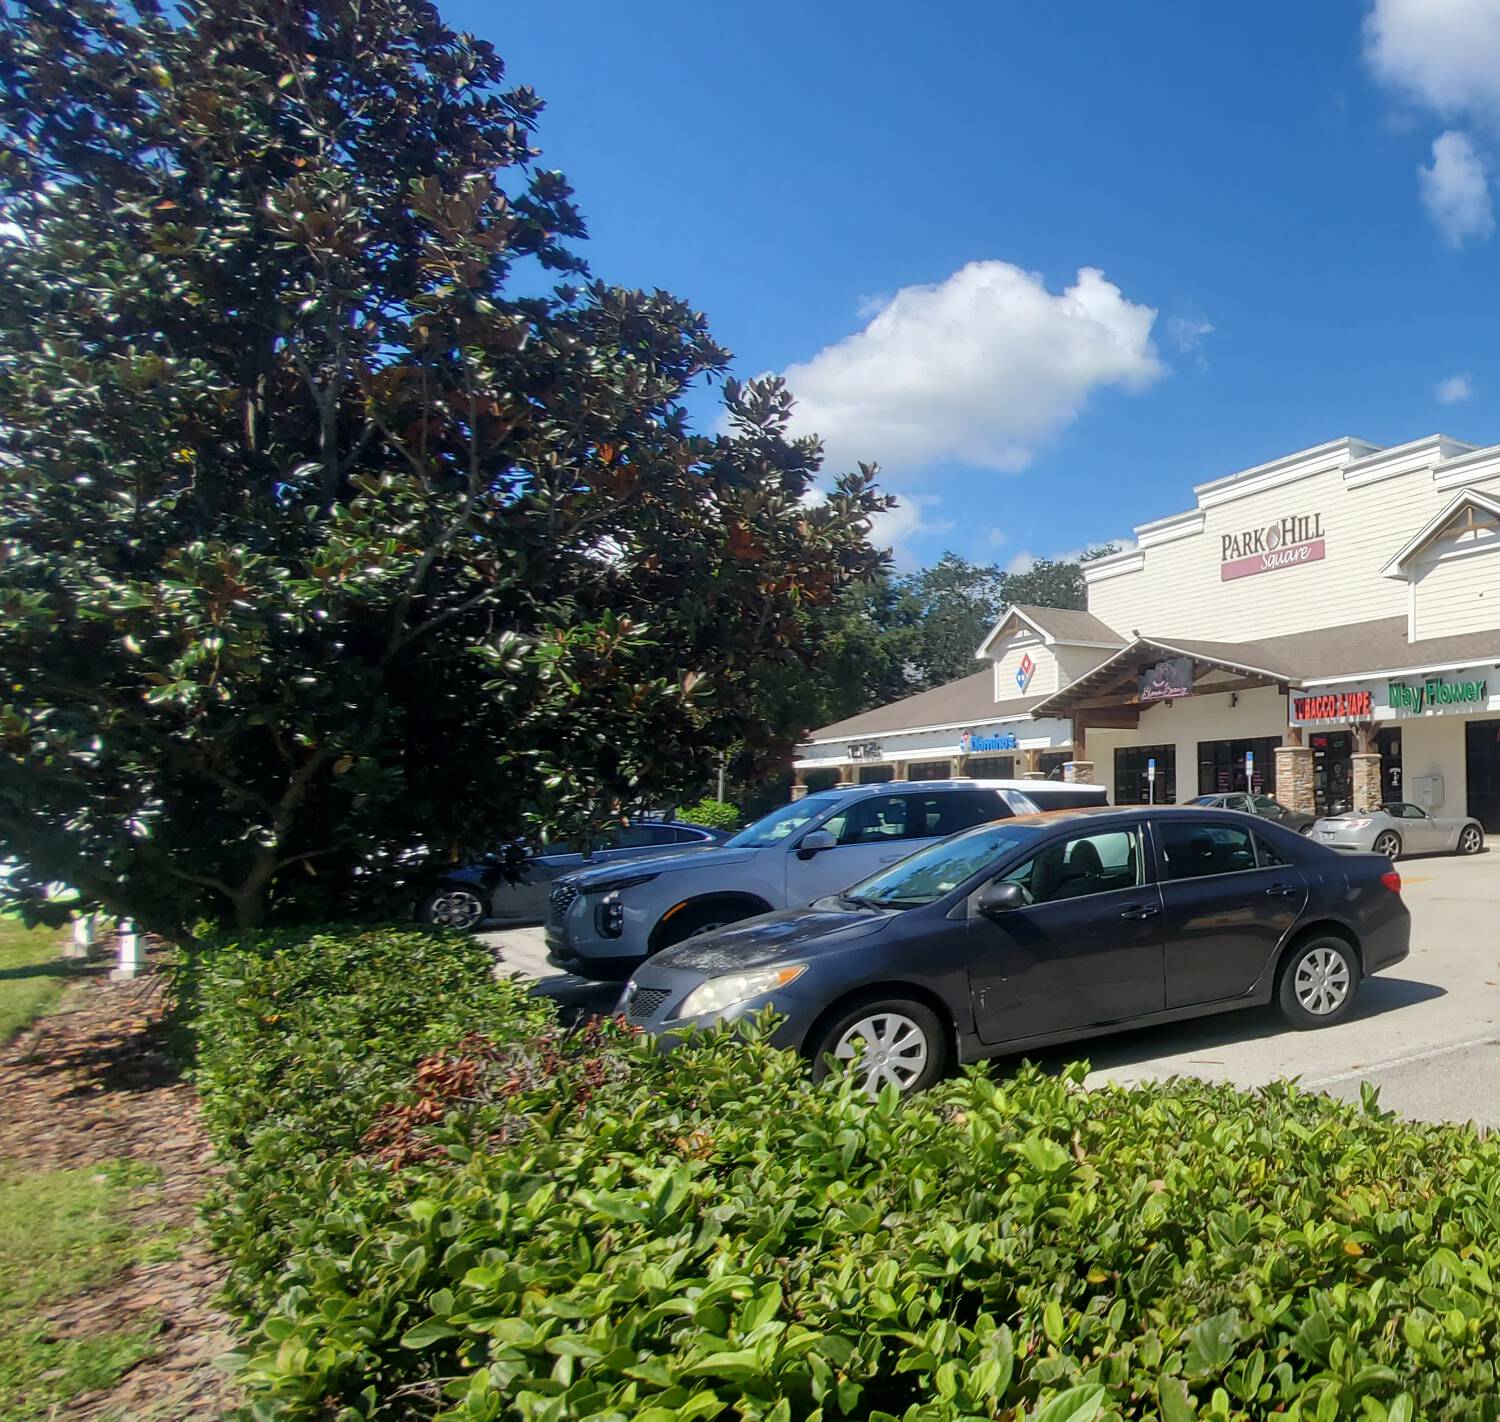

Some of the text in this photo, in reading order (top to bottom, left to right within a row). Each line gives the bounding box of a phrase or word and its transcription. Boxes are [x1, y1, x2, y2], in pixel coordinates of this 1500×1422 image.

[1221, 513, 1325, 561] PARK HILL
[1261, 546, 1311, 570] Square
[1294, 691, 1372, 721] TOBACCO & VAPE
[1388, 678, 1486, 714] May Flower
